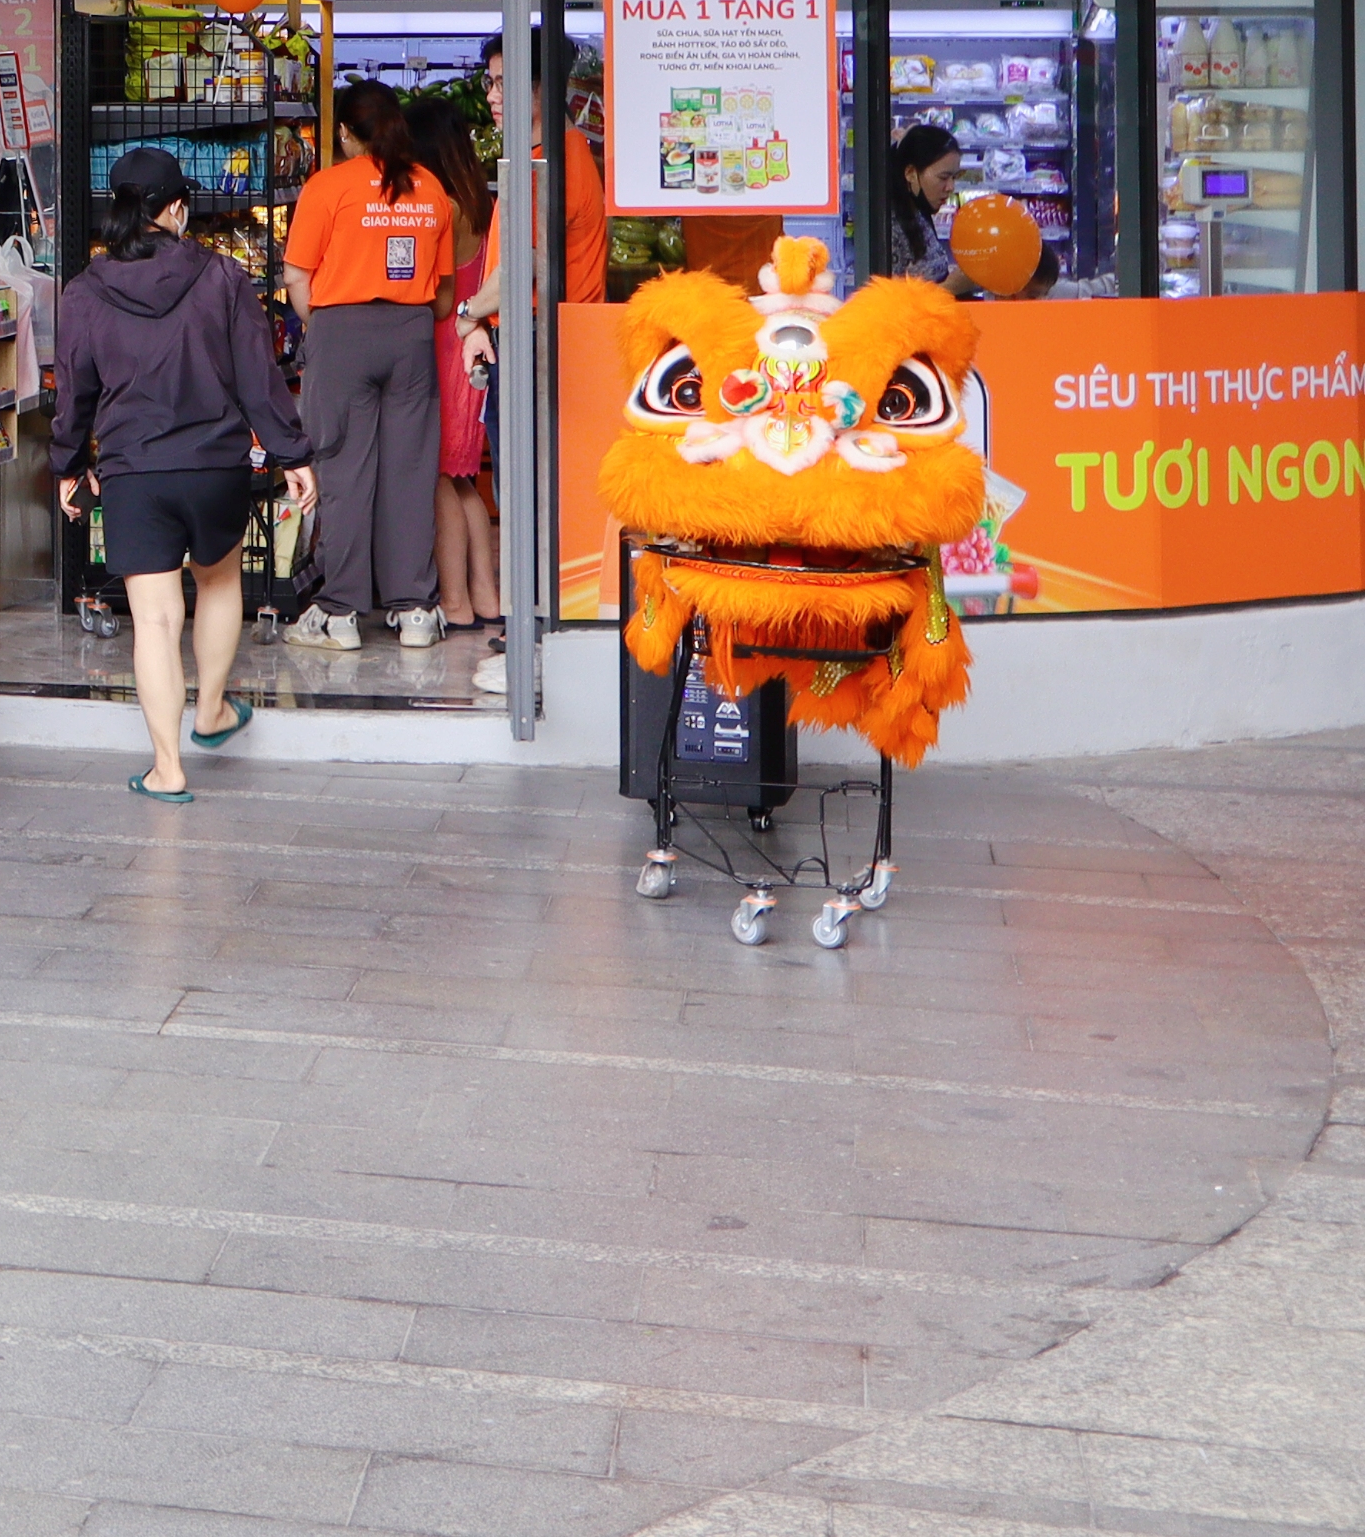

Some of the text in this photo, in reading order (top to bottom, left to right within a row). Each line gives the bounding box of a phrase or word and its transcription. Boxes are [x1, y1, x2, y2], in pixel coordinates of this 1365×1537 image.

[14, 8, 33, 35] 2
[622, 0, 686, 21] MUA
[696, 0, 711, 20] 1
[805, 0, 819, 19] 1
[23, 43, 42, 72] 1
[640, 52, 664, 60] RONG
[366, 203, 434, 214] MUA ONLINE
[361, 216, 437, 227] GIAO NGAY 2H
[1054, 350, 1365, 414] SIÊU THỊ THỰC PHẨM
[1055, 438, 1209, 512] TƯƠI
